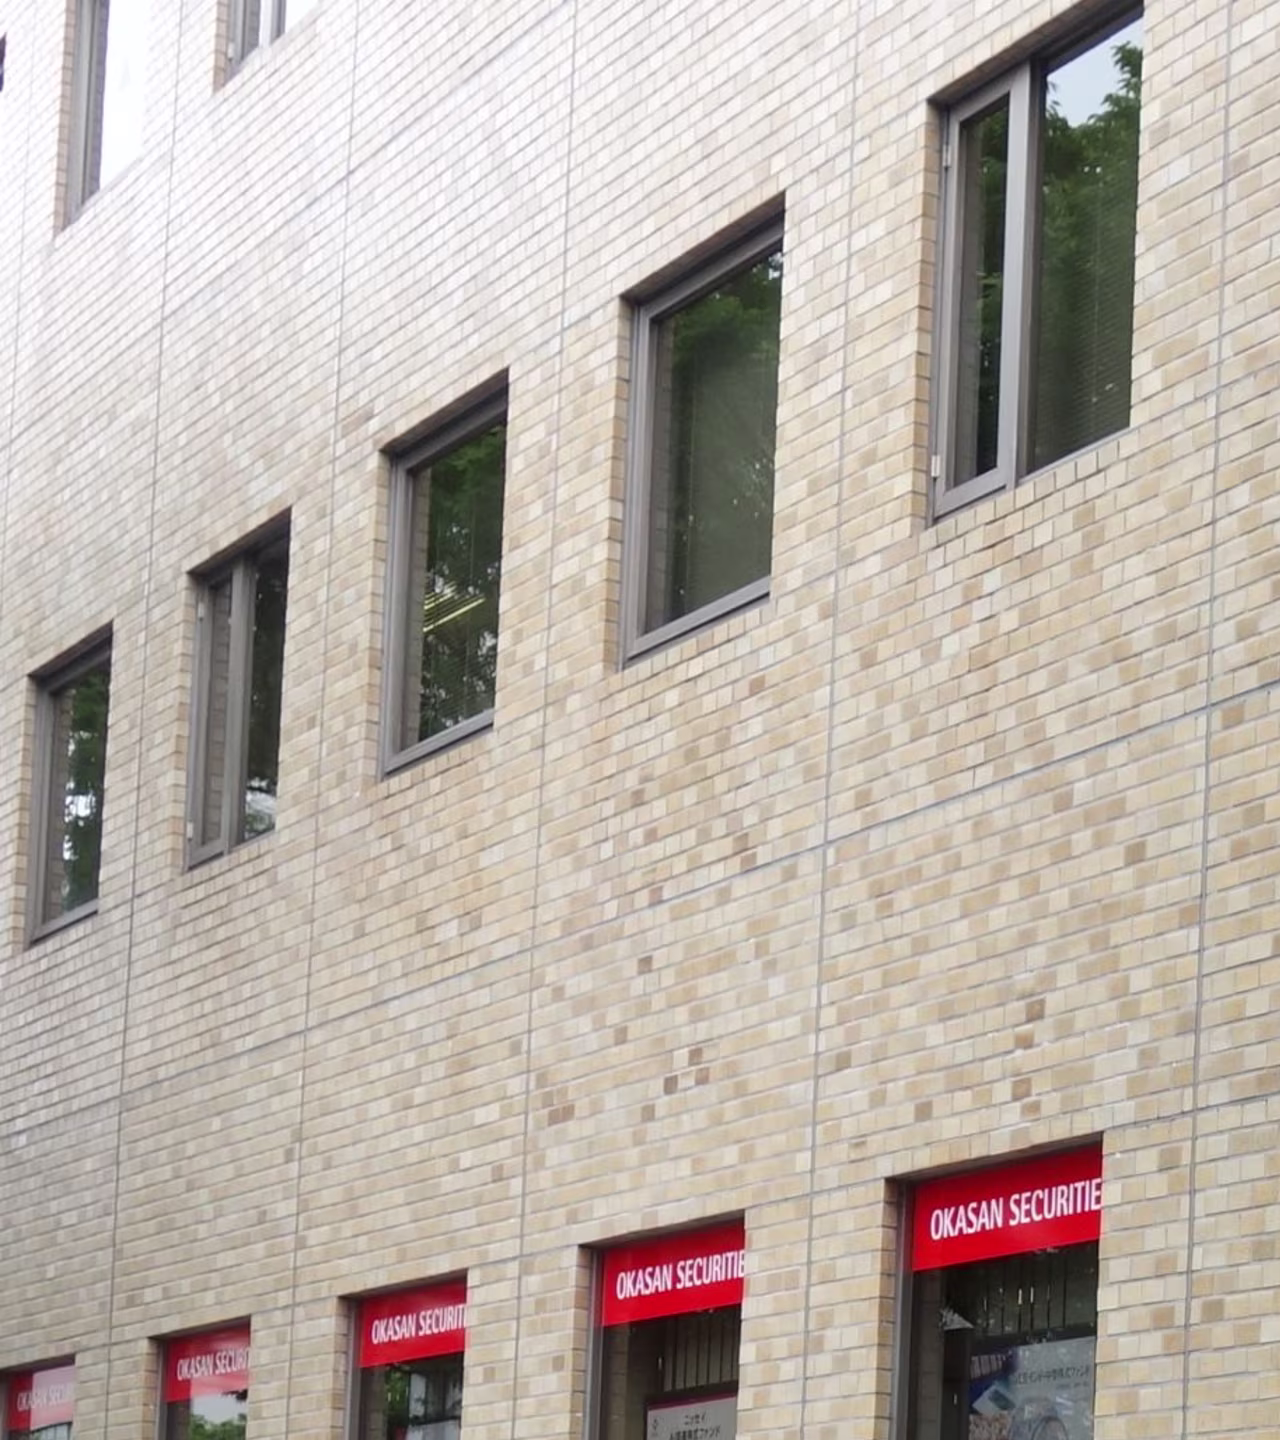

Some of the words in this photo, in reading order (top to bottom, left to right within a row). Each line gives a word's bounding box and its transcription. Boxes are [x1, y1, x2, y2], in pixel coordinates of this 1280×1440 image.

[930, 1197, 1004, 1241] OKASAN
[616, 1263, 673, 1300] OKASAN
[371, 1313, 417, 1345] OKASAN
[177, 1353, 214, 1381] OKASAN
